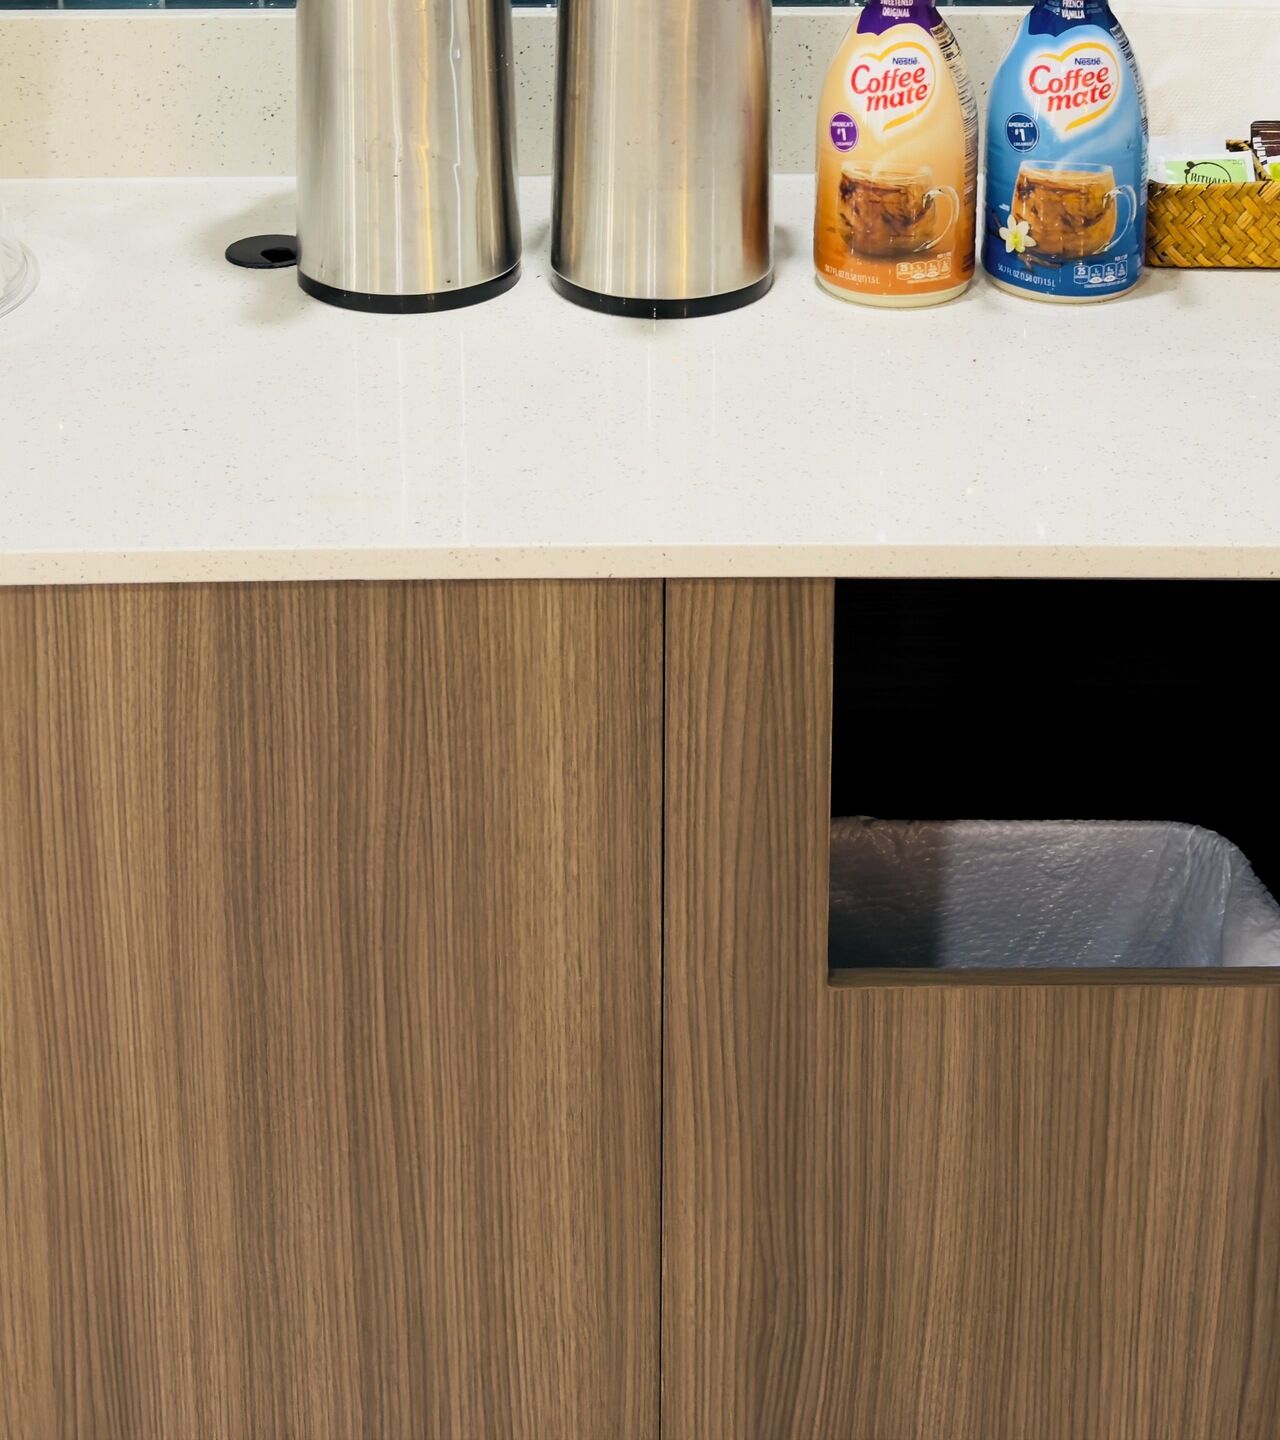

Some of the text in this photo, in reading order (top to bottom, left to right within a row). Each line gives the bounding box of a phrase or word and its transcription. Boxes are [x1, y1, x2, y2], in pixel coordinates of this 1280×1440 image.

[1061, 8, 1086, 19] VANILLA
[1062, 0, 1085, 9] FRENCH
[850, 64, 926, 95] Coffee
[1028, 64, 1110, 95] Coffee
[866, 83, 929, 112] mate
[1047, 83, 1113, 112] mate
